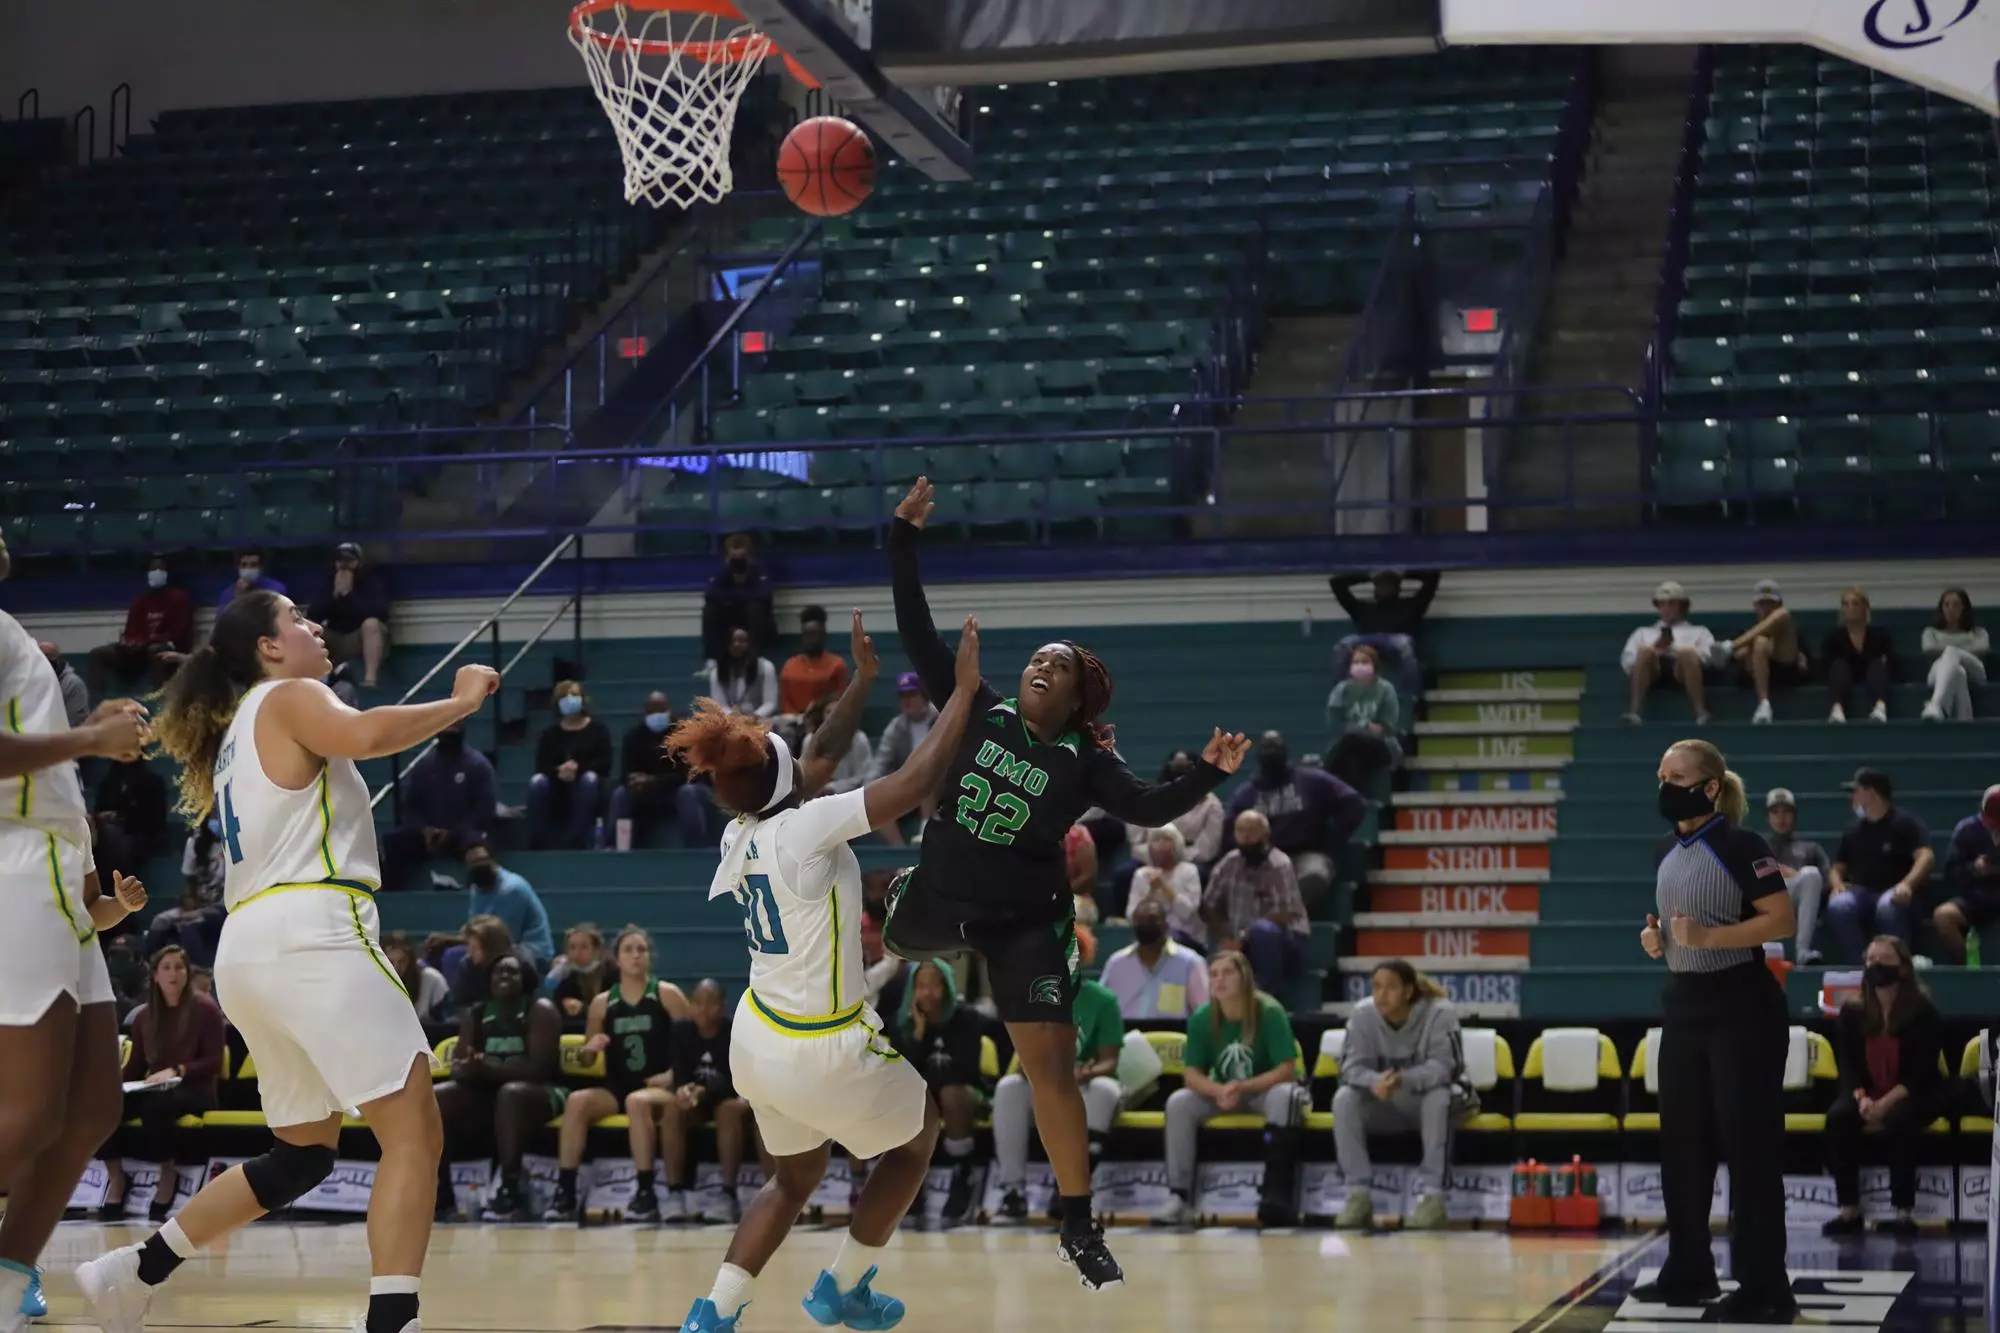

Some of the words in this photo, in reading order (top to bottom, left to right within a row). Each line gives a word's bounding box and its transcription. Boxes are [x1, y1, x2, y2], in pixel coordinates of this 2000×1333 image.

[1478, 704, 1541, 724] WITH
[1478, 736, 1527, 757] LIVE
[975, 739, 1049, 796] UMO
[956, 772, 1031, 845] 22
[1411, 809, 1442, 831] TO
[1451, 807, 1557, 832] CAMPUS
[1421, 886, 1508, 913] BLOCK
[1424, 930, 1479, 957] ONE
[624, 1034, 646, 1071] 3
